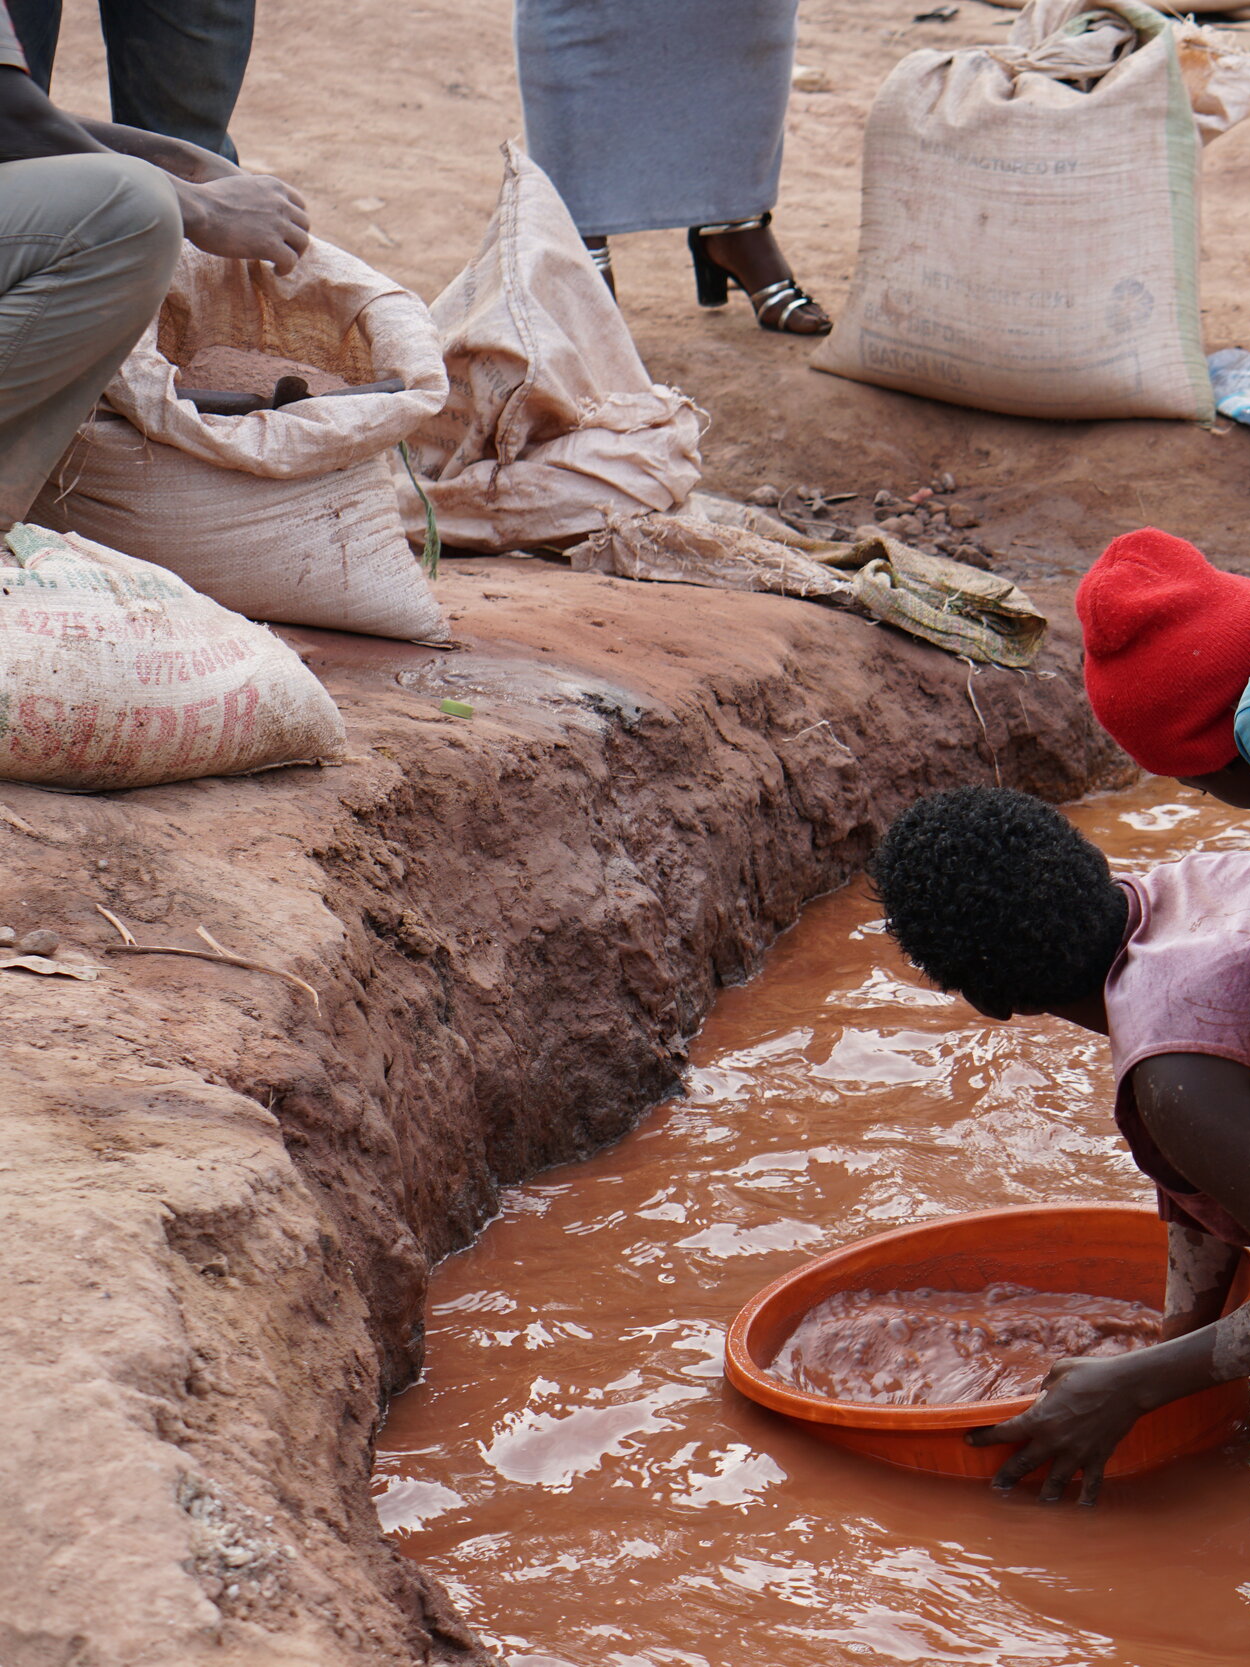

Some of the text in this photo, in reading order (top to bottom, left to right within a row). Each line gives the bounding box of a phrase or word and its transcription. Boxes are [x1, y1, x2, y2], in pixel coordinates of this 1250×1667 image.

[1054, 159, 1078, 175] BY
[867, 340, 930, 377] BATCH
[9, 681, 260, 771] SUPER
